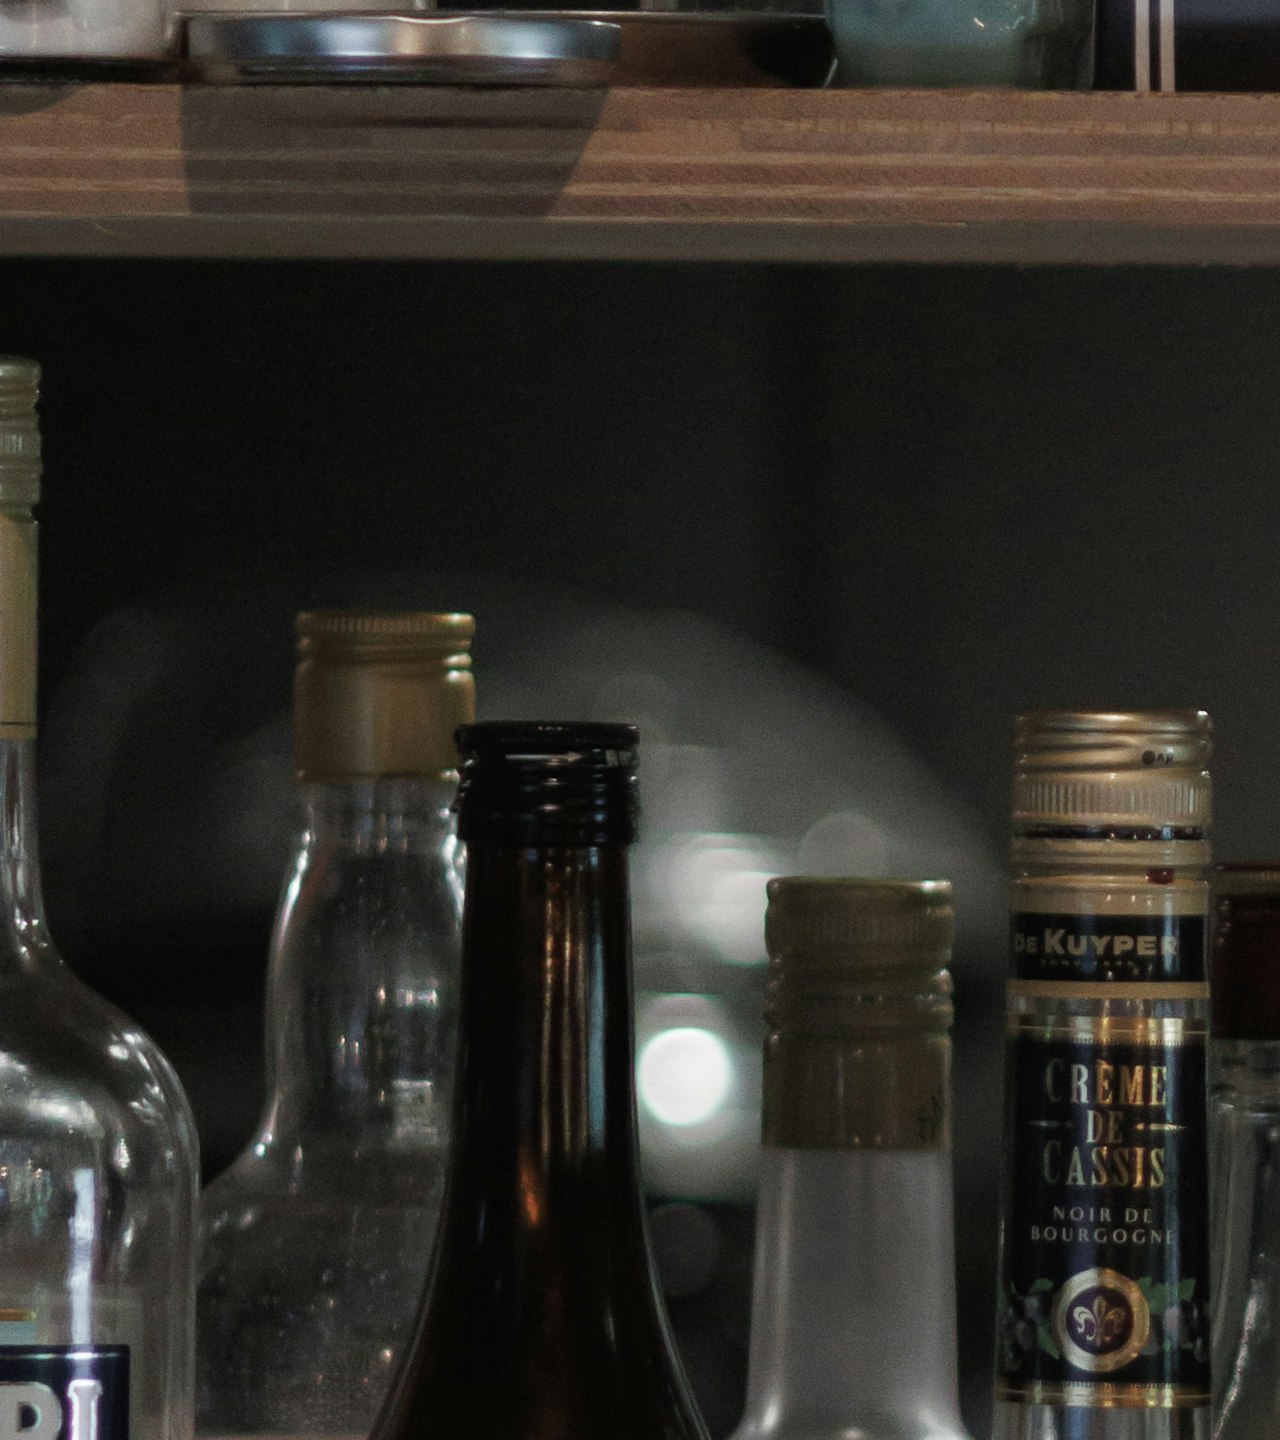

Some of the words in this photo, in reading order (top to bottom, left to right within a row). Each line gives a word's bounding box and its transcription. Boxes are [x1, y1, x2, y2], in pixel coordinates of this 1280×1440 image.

[1043, 927, 1178, 957] KUYPER
[1042, 1060, 1169, 1106] CRÈME
[1085, 1109, 1124, 1142] DE
[1041, 1147, 1165, 1189] CASSIS
[1052, 1205, 1113, 1223] NOIR
[1125, 1206, 1155, 1223] DE
[1030, 1224, 1175, 1245] BOURGOGNE
